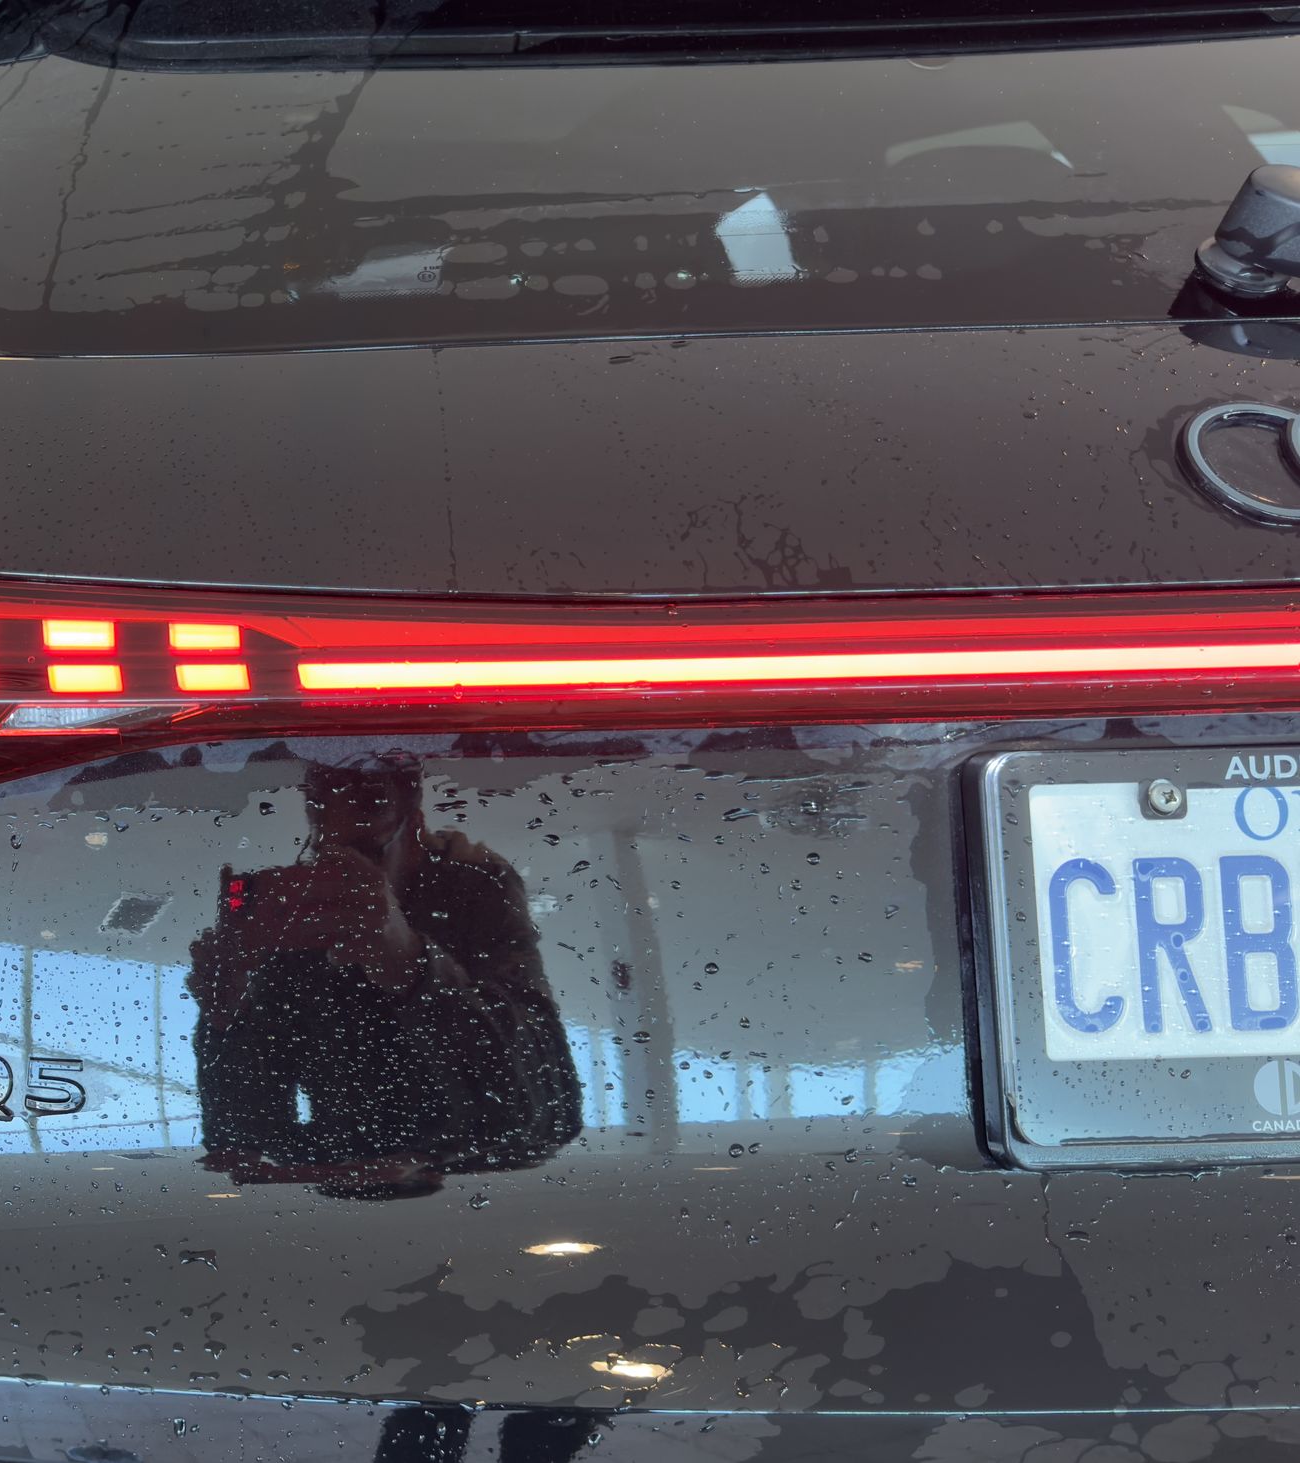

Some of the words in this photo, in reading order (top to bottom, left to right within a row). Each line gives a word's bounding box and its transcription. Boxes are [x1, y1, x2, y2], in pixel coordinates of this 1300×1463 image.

[1225, 755, 1300, 780] AUD
[1234, 786, 1300, 841] O
[1048, 855, 1298, 1033] CRB
